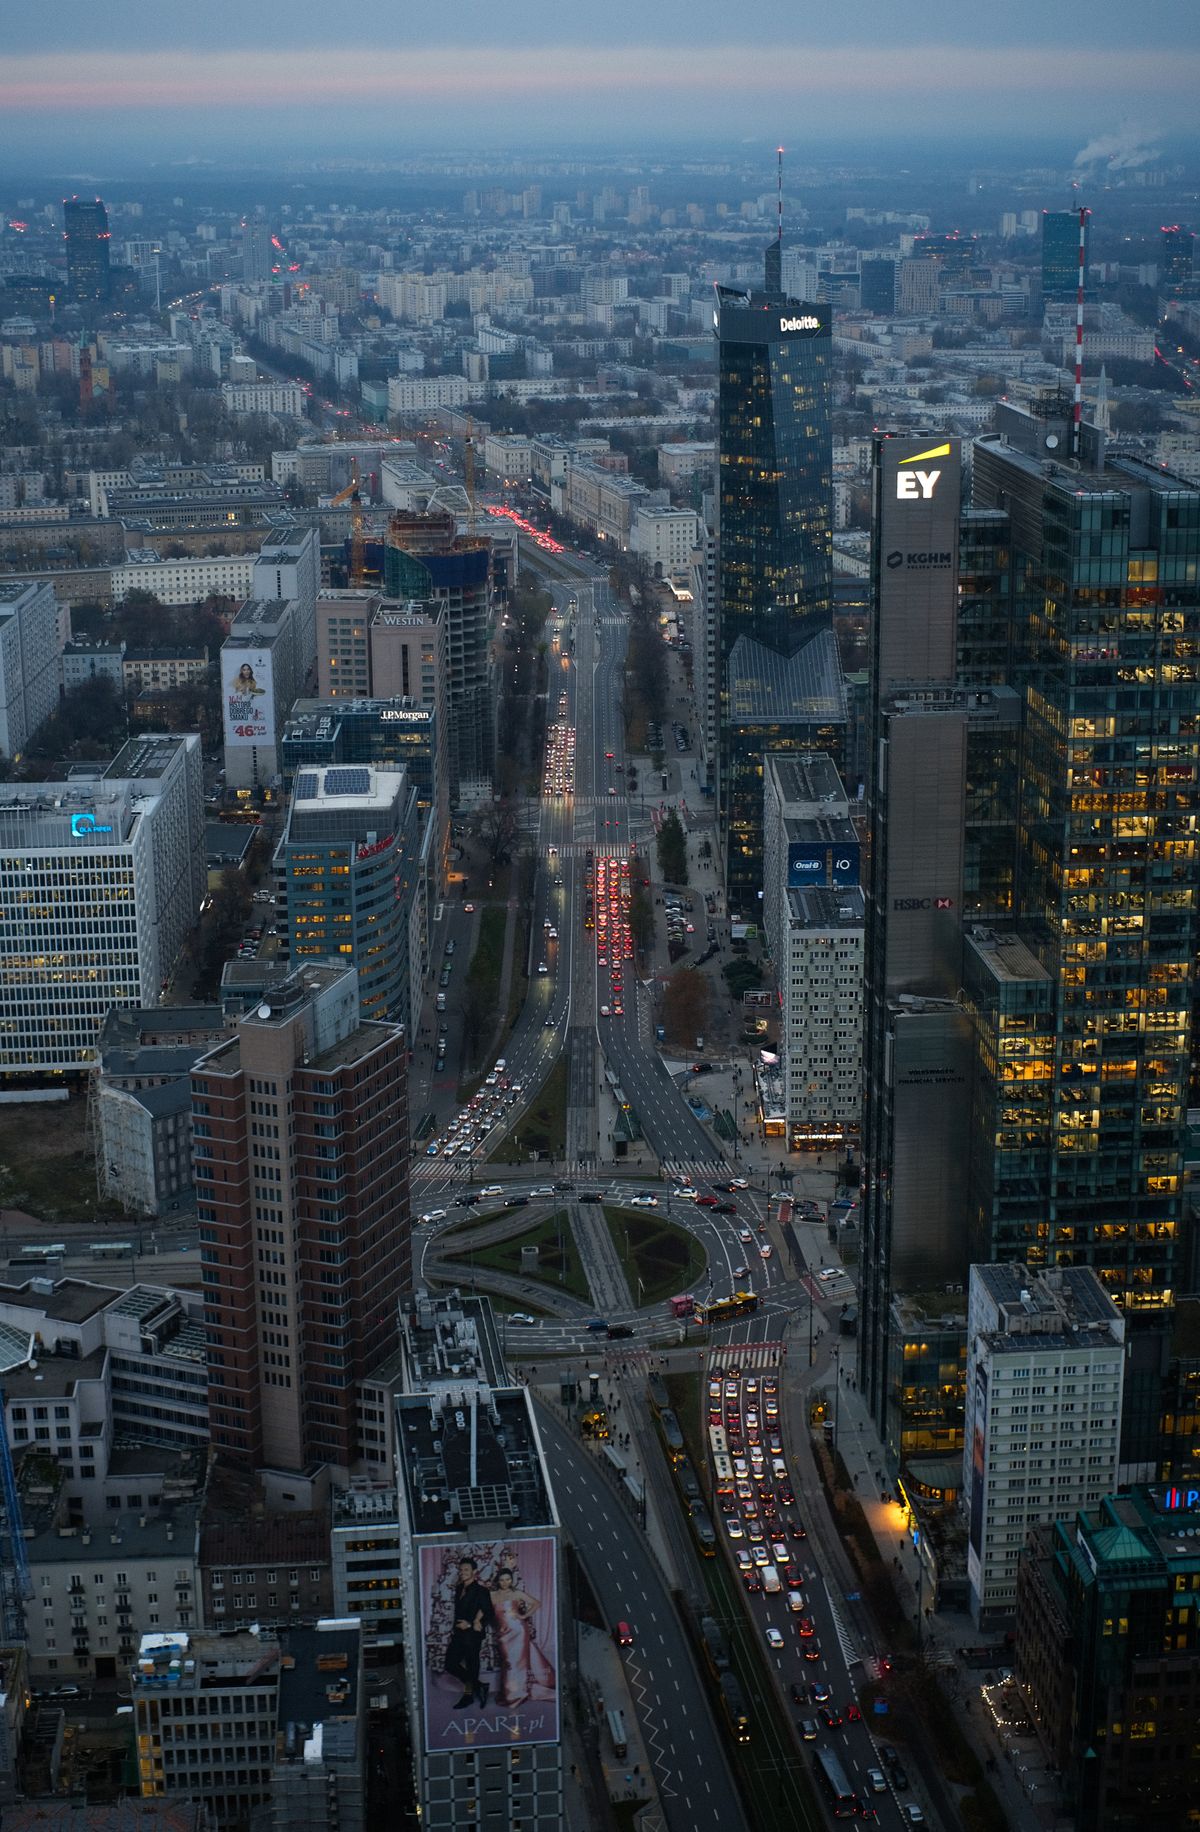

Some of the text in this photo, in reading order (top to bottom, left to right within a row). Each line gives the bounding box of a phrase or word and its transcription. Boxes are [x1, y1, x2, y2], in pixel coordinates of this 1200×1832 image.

[896, 470, 941, 499] EY
[907, 552, 952, 563] KGHM
[384, 616, 424, 626] WESTIN
[235, 725, 254, 736] 46
[894, 898, 931, 910] HSBC
